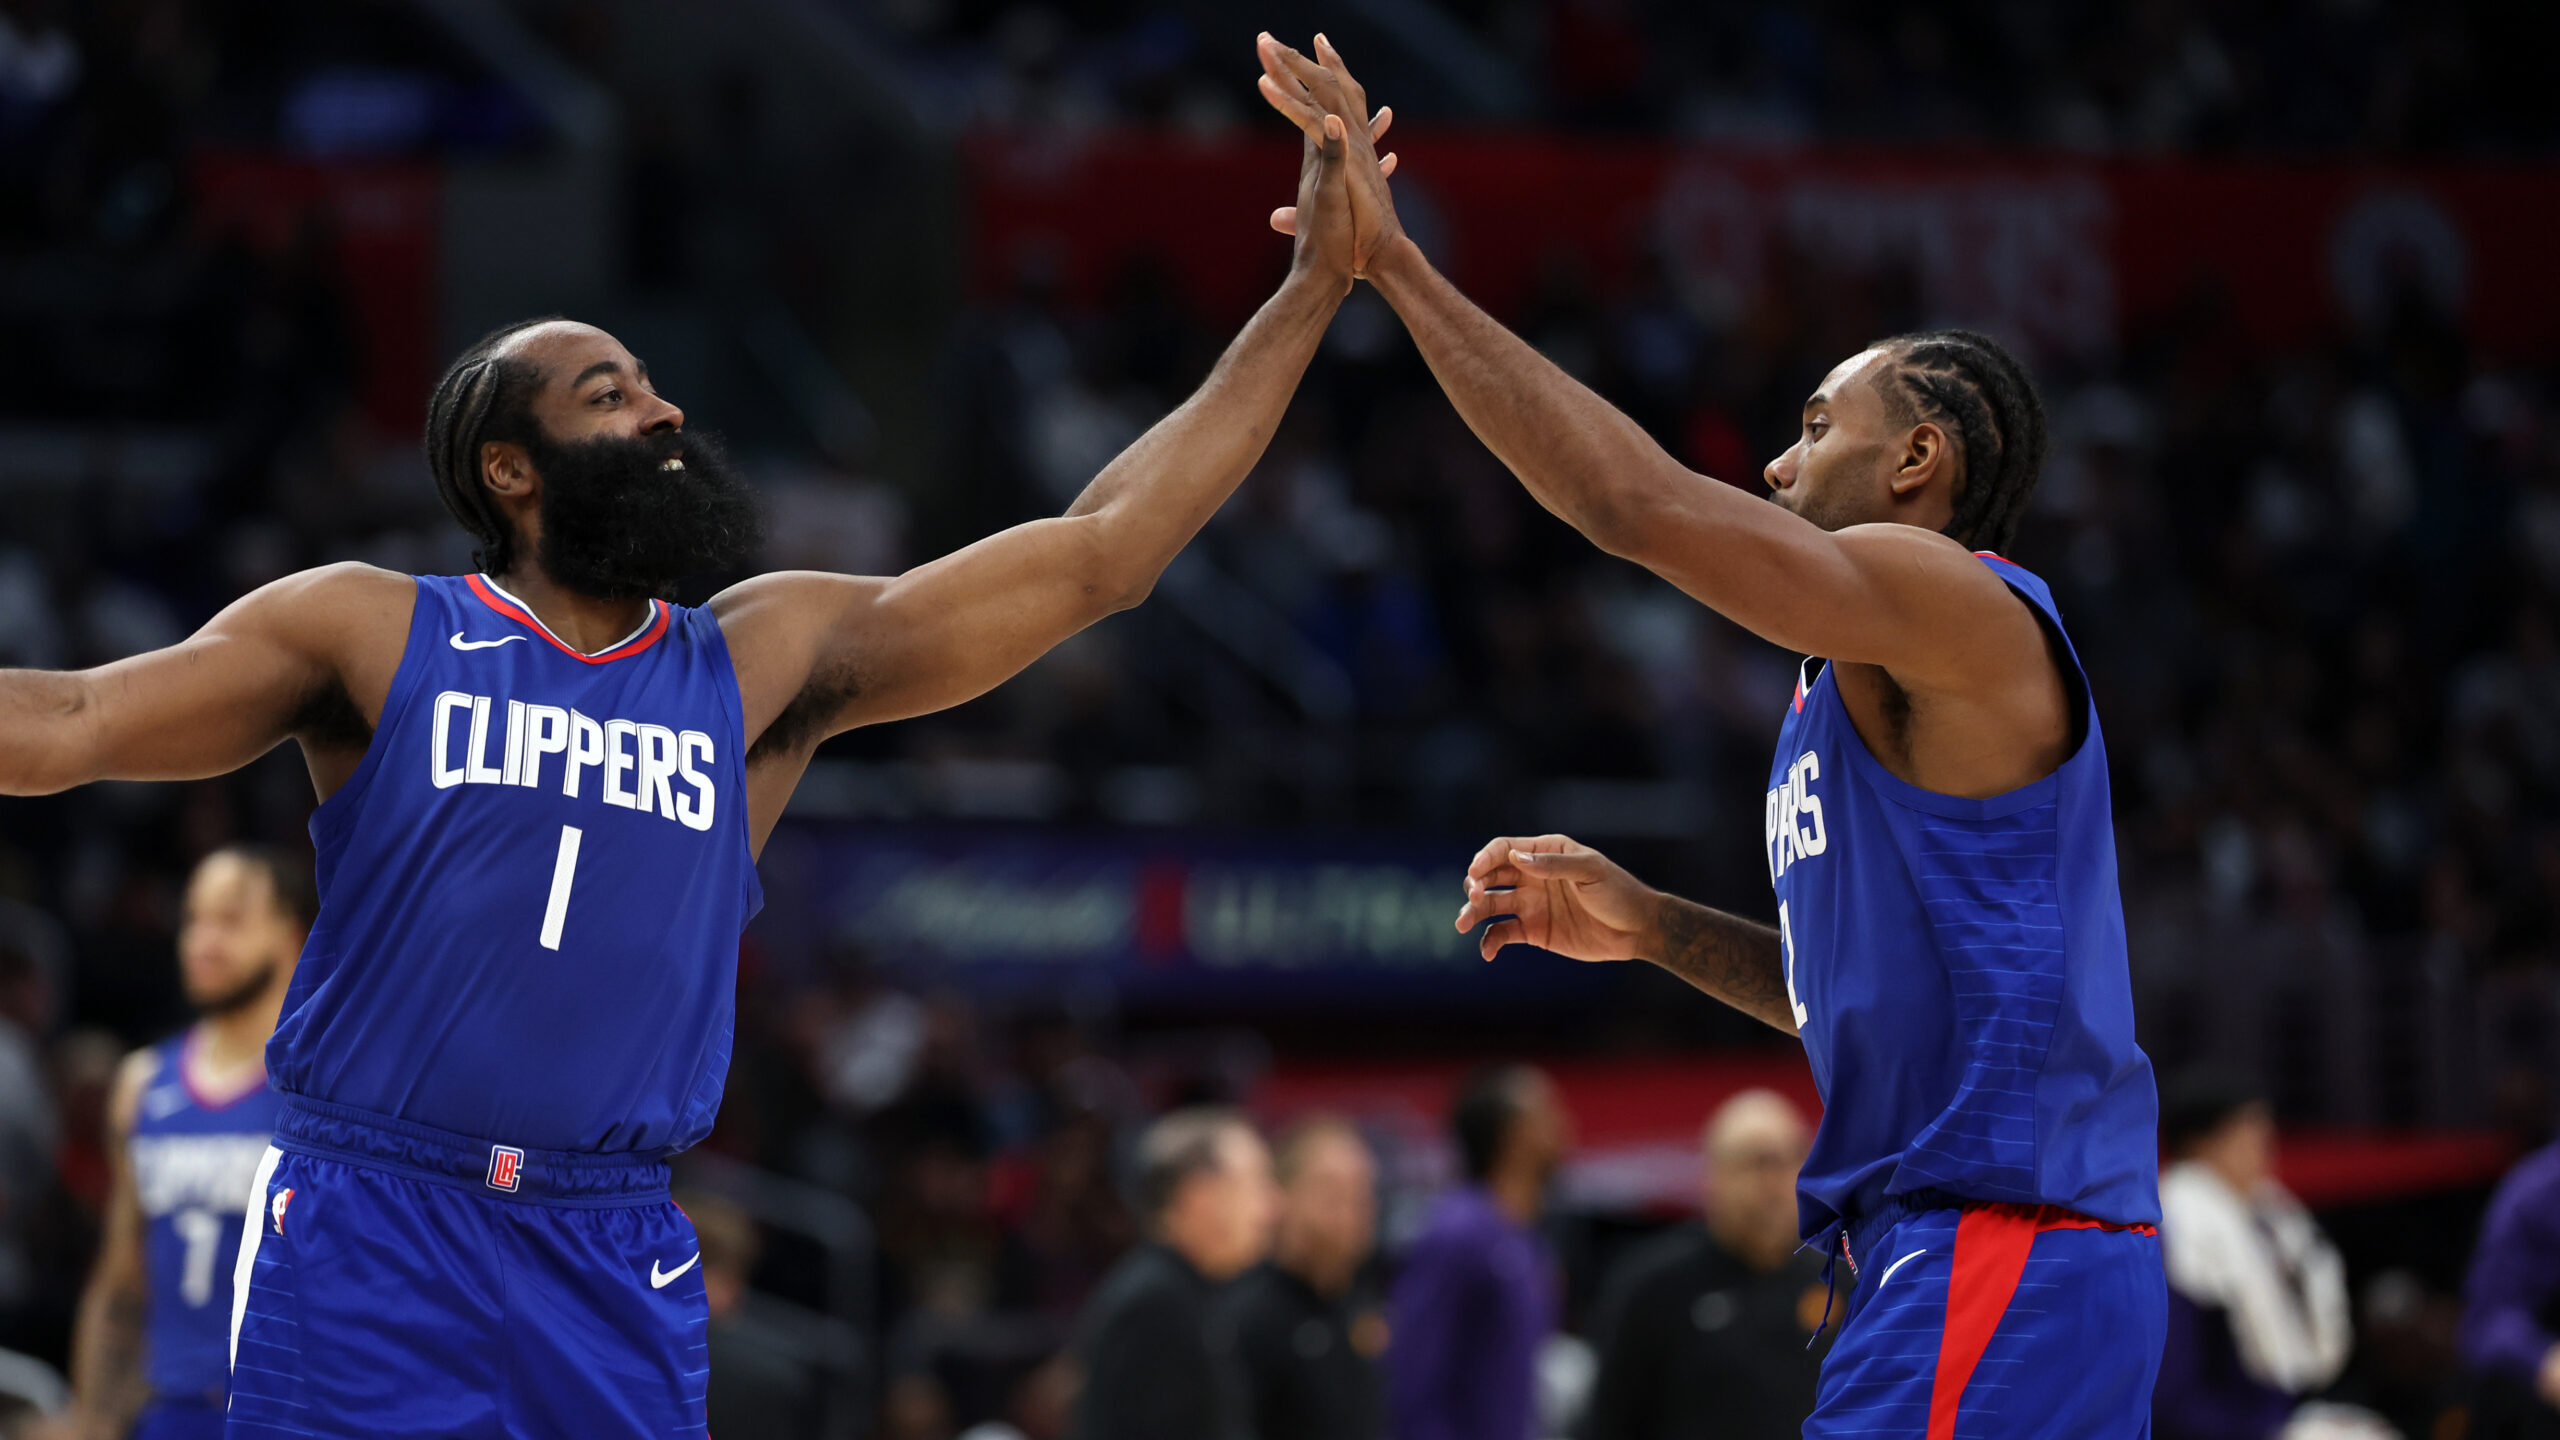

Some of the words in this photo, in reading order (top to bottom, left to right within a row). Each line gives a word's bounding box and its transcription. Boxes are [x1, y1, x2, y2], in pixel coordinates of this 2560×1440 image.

[431, 690, 716, 832] CLIPPERS
[539, 824, 583, 952] 1
[1778, 898, 1809, 1030] 2
